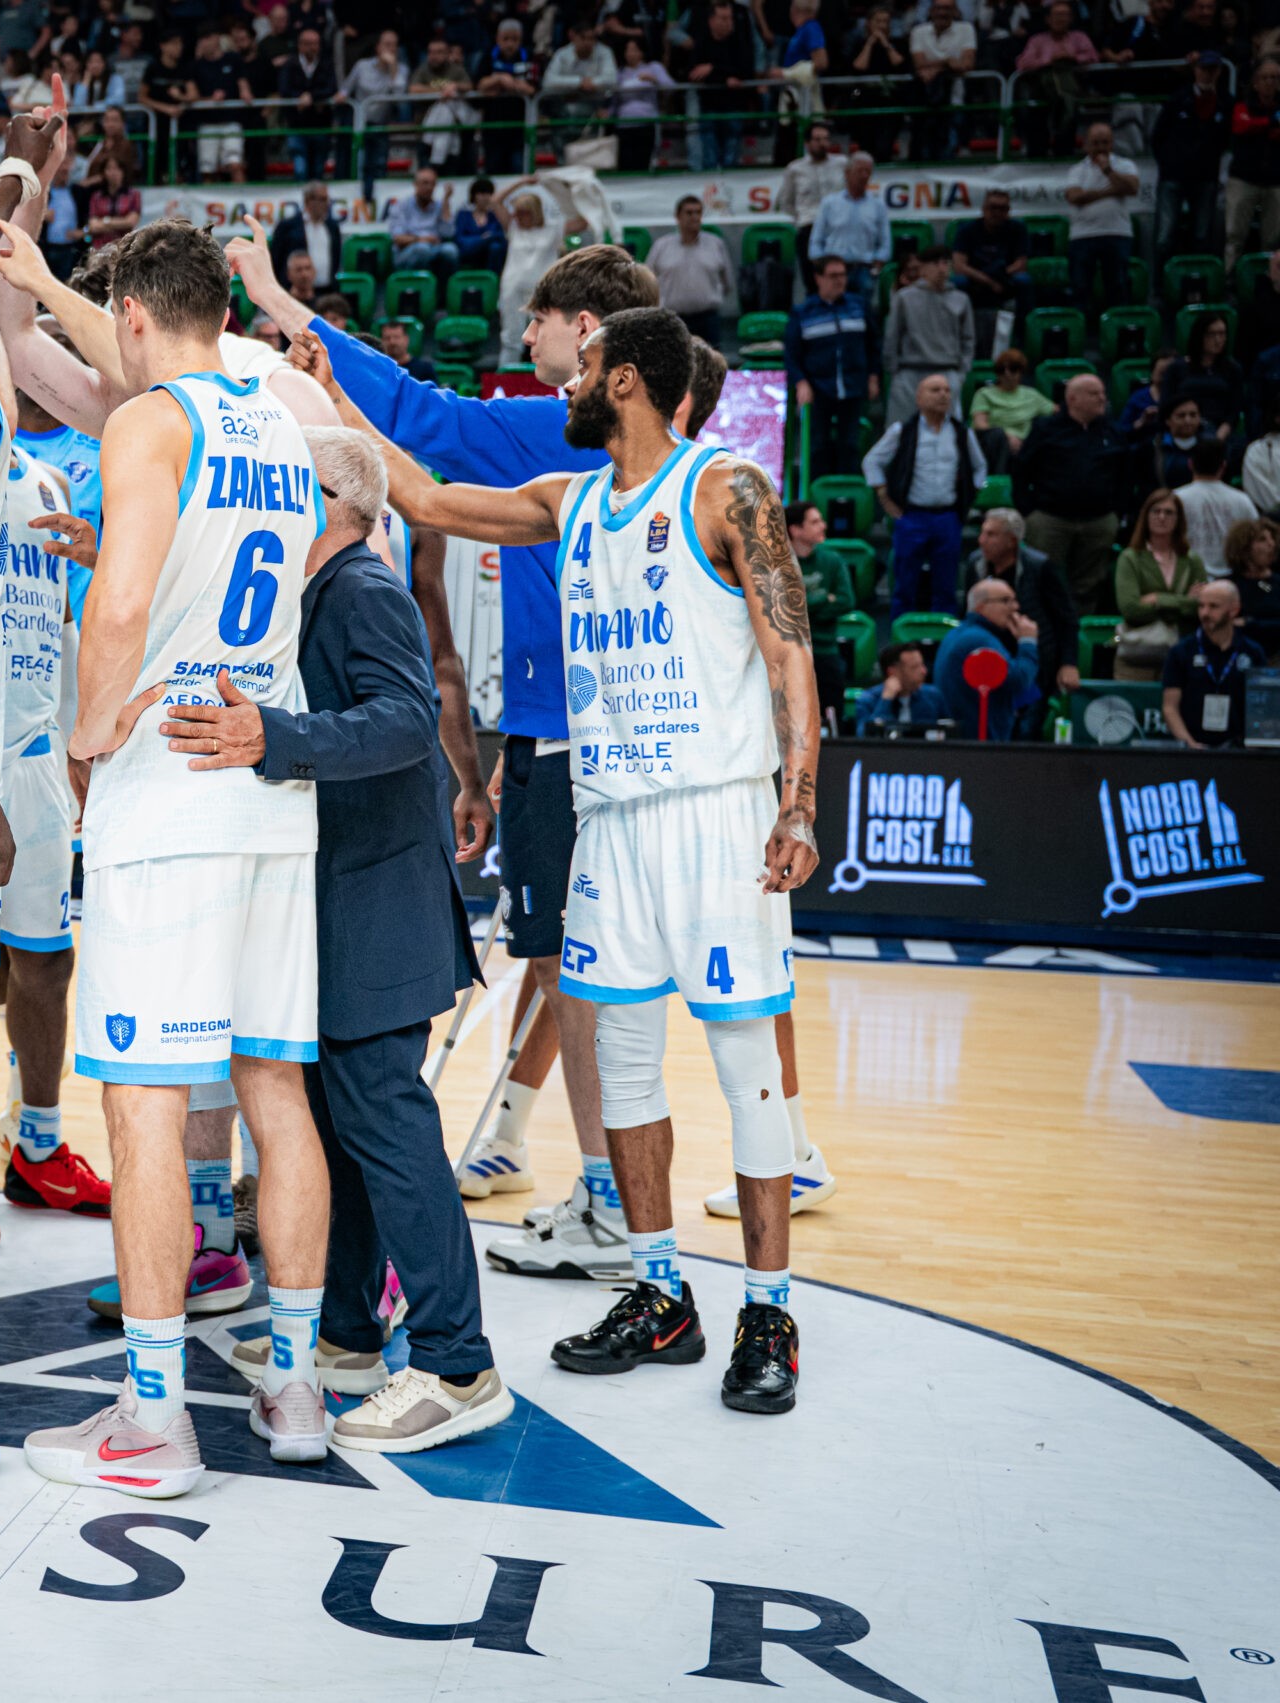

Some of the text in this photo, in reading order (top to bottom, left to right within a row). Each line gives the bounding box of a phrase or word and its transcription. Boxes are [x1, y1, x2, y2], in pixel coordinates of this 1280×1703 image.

[206, 197, 398, 226] SARDGNA
[572, 522, 592, 568] 4
[650, 528, 667, 537] LBA
[6, 583, 53, 608] Banco
[218, 530, 284, 647] 6
[600, 656, 684, 686] Banco di
[602, 688, 698, 716] Sardegna
[633, 721, 700, 736] sardares
[606, 742, 672, 760] REALE
[605, 762, 672, 774] MUUA
[867, 772, 945, 819] NORD
[1119, 778, 1204, 834] NORD
[706, 946, 735, 994] 4
[160, 1031, 232, 1045] sardegnaturismo.i
[161, 1018, 232, 1034] SARDEGNA
